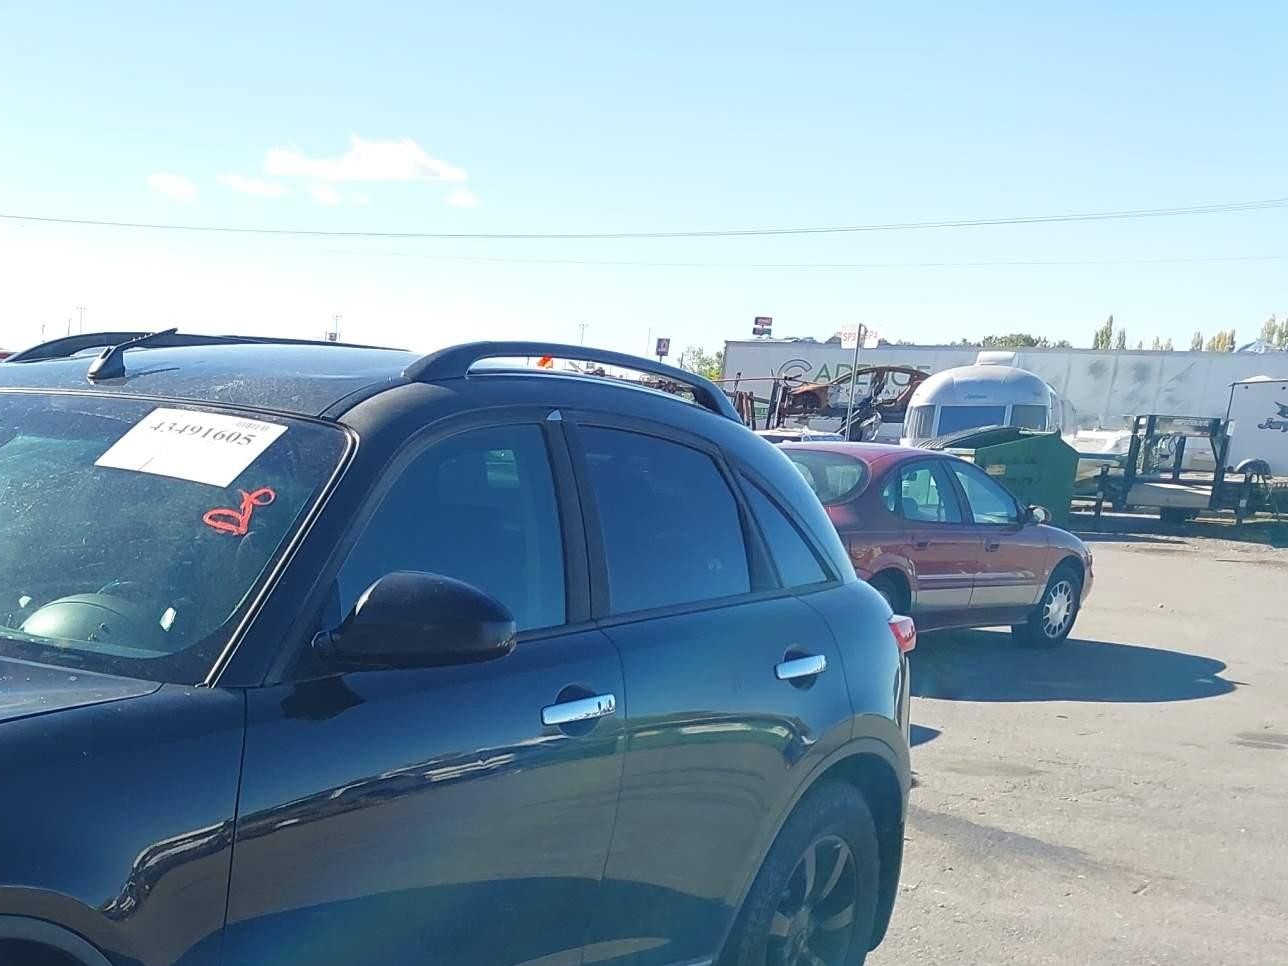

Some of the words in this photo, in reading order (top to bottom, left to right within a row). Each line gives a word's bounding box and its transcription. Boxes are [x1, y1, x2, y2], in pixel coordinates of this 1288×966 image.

[842, 332, 856, 342] SP3
[777, 359, 931, 388] CADEC
[150, 421, 256, 446] 43491605
